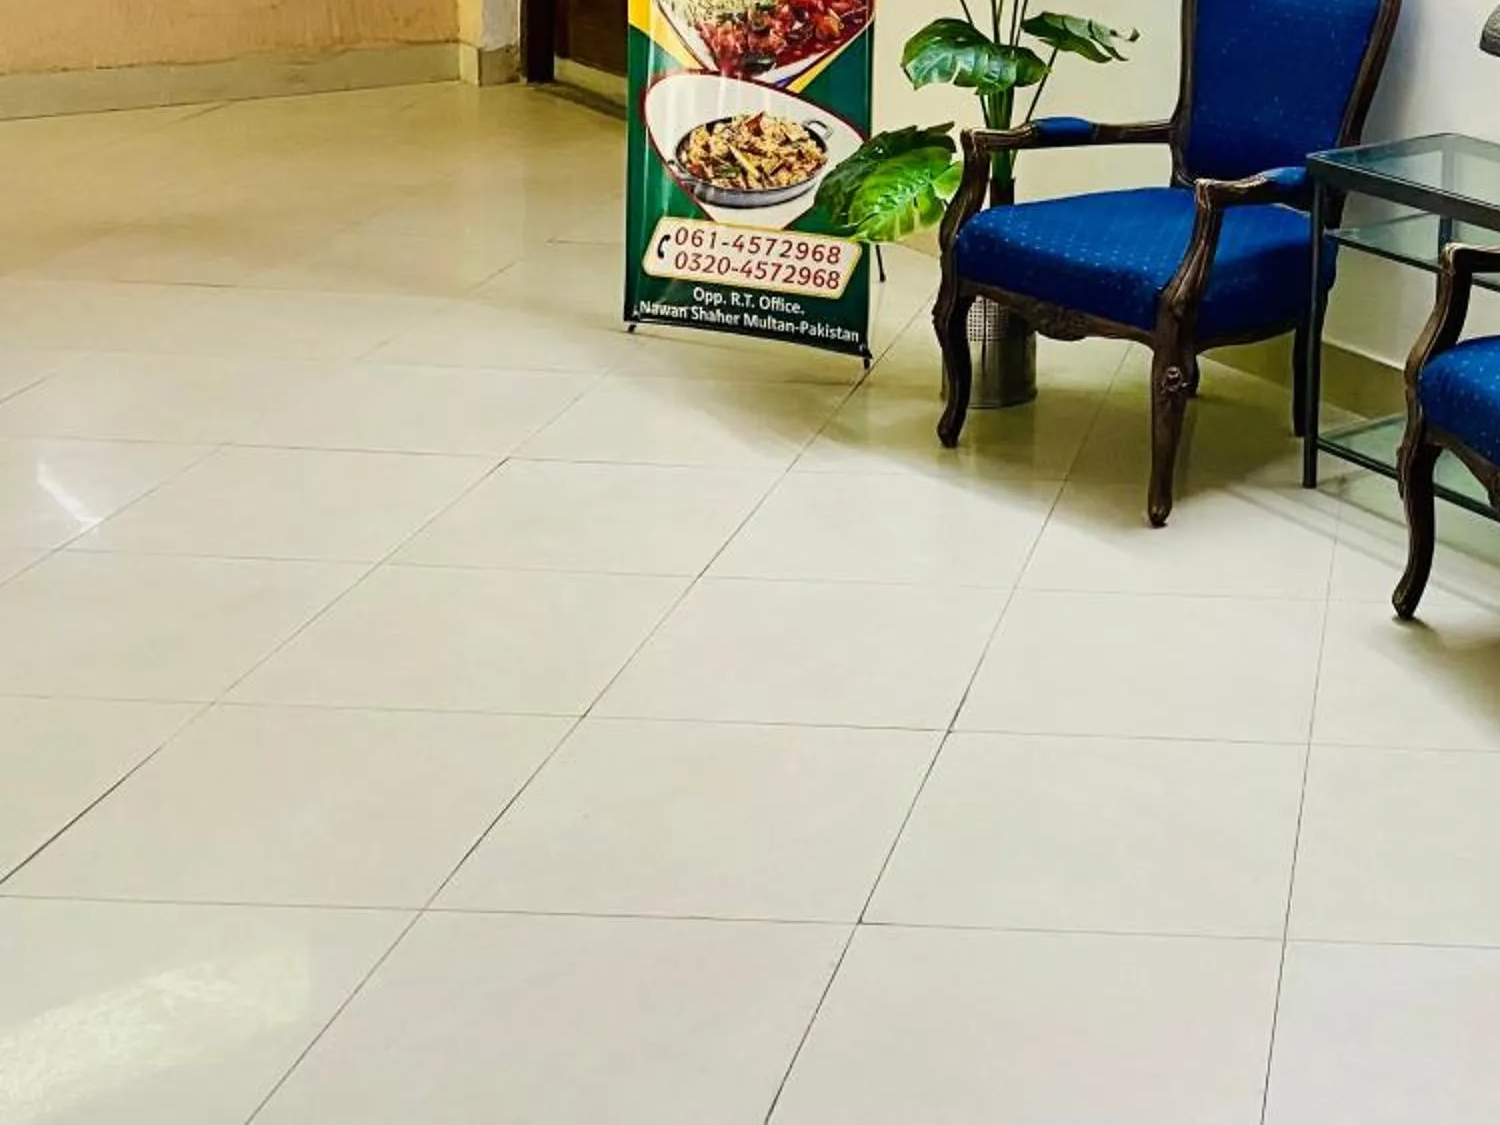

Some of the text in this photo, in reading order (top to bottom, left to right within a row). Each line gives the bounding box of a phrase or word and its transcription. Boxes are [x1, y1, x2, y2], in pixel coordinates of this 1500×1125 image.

[674, 226, 841, 264] 061-4572968
[674, 251, 841, 290] 0320-4572968
[693, 287, 726, 305] Opp.
[731, 292, 755, 308] R.T.
[639, 300, 859, 343] Nawan Shaher Multan-Pakistan
